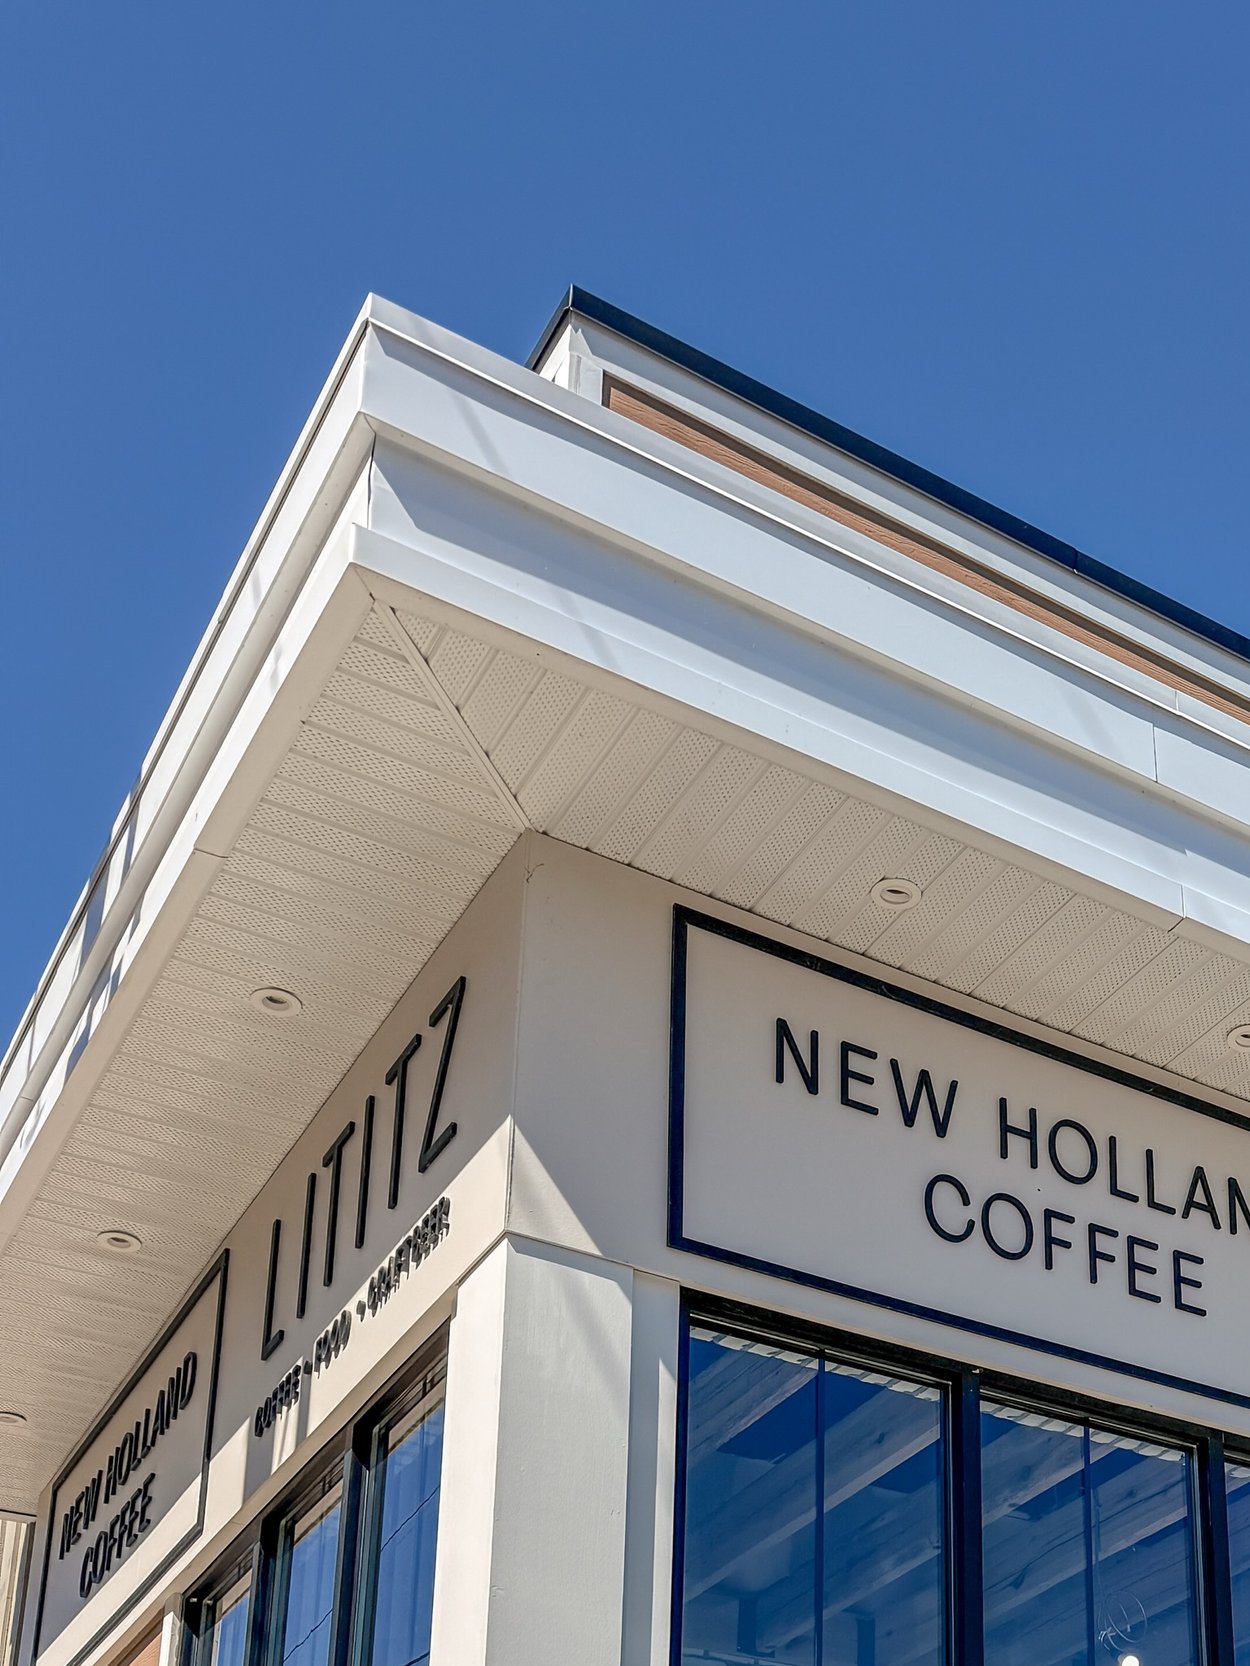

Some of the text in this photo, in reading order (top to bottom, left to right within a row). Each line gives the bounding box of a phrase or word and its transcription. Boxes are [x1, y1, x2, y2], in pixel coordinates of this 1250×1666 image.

[775, 1017, 959, 1138] NEW
[261, 975, 466, 1361] LITITZ
[924, 1173, 1207, 1317] COFFEE
[255, 1364, 302, 1438] COFFEE
[314, 1310, 352, 1375] FOOD
[59, 1351, 198, 1560] NEW HOLLAND
[80, 1472, 156, 1599] COFFEE
